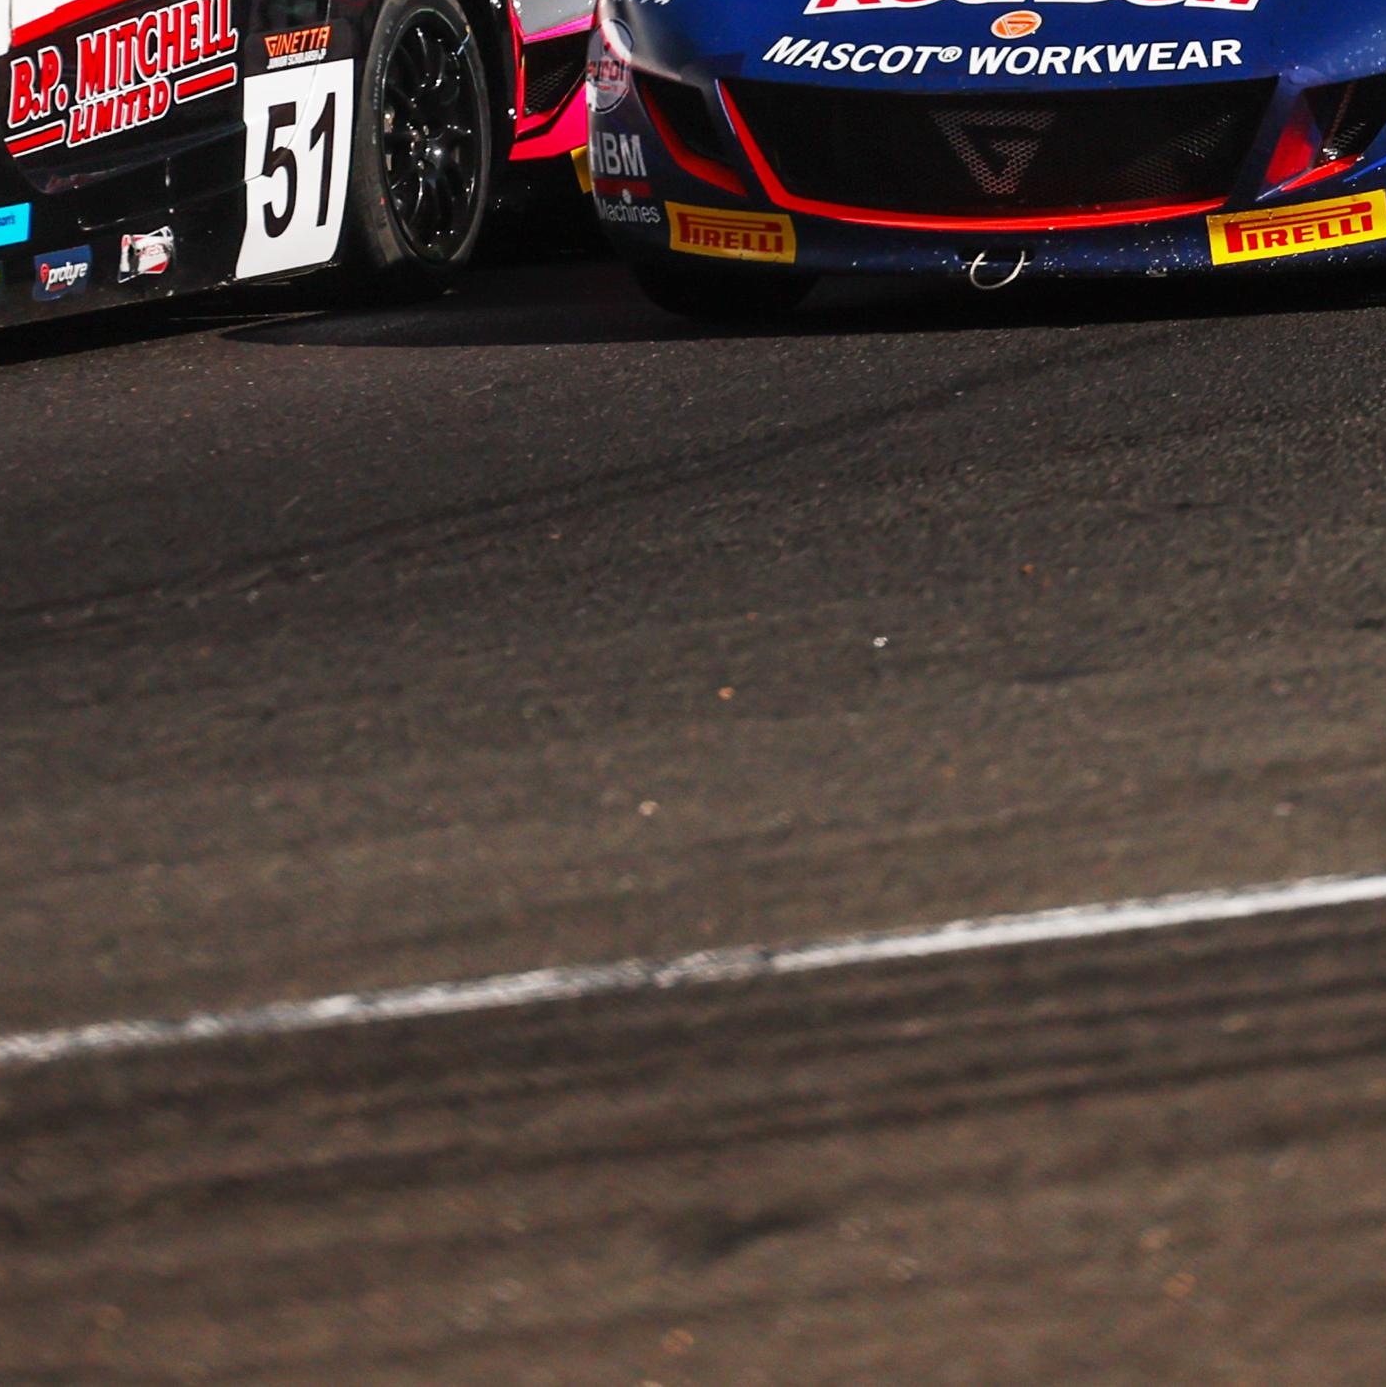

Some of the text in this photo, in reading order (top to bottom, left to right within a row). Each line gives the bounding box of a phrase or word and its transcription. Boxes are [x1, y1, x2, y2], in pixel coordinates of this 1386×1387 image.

[264, 26, 331, 58] GINETTA
[968, 39, 1242, 75] WORKWEAR
[7, 46, 70, 128] B.P.
[67, 77, 172, 148] LIMITED
[263, 91, 337, 239] 51
[590, 131, 647, 177] HBM
[596, 199, 661, 224] Machines
[677, 212, 783, 254] PIRELLI
[1226, 200, 1376, 254] PIRELLI
[45, 261, 88, 291] protyre
